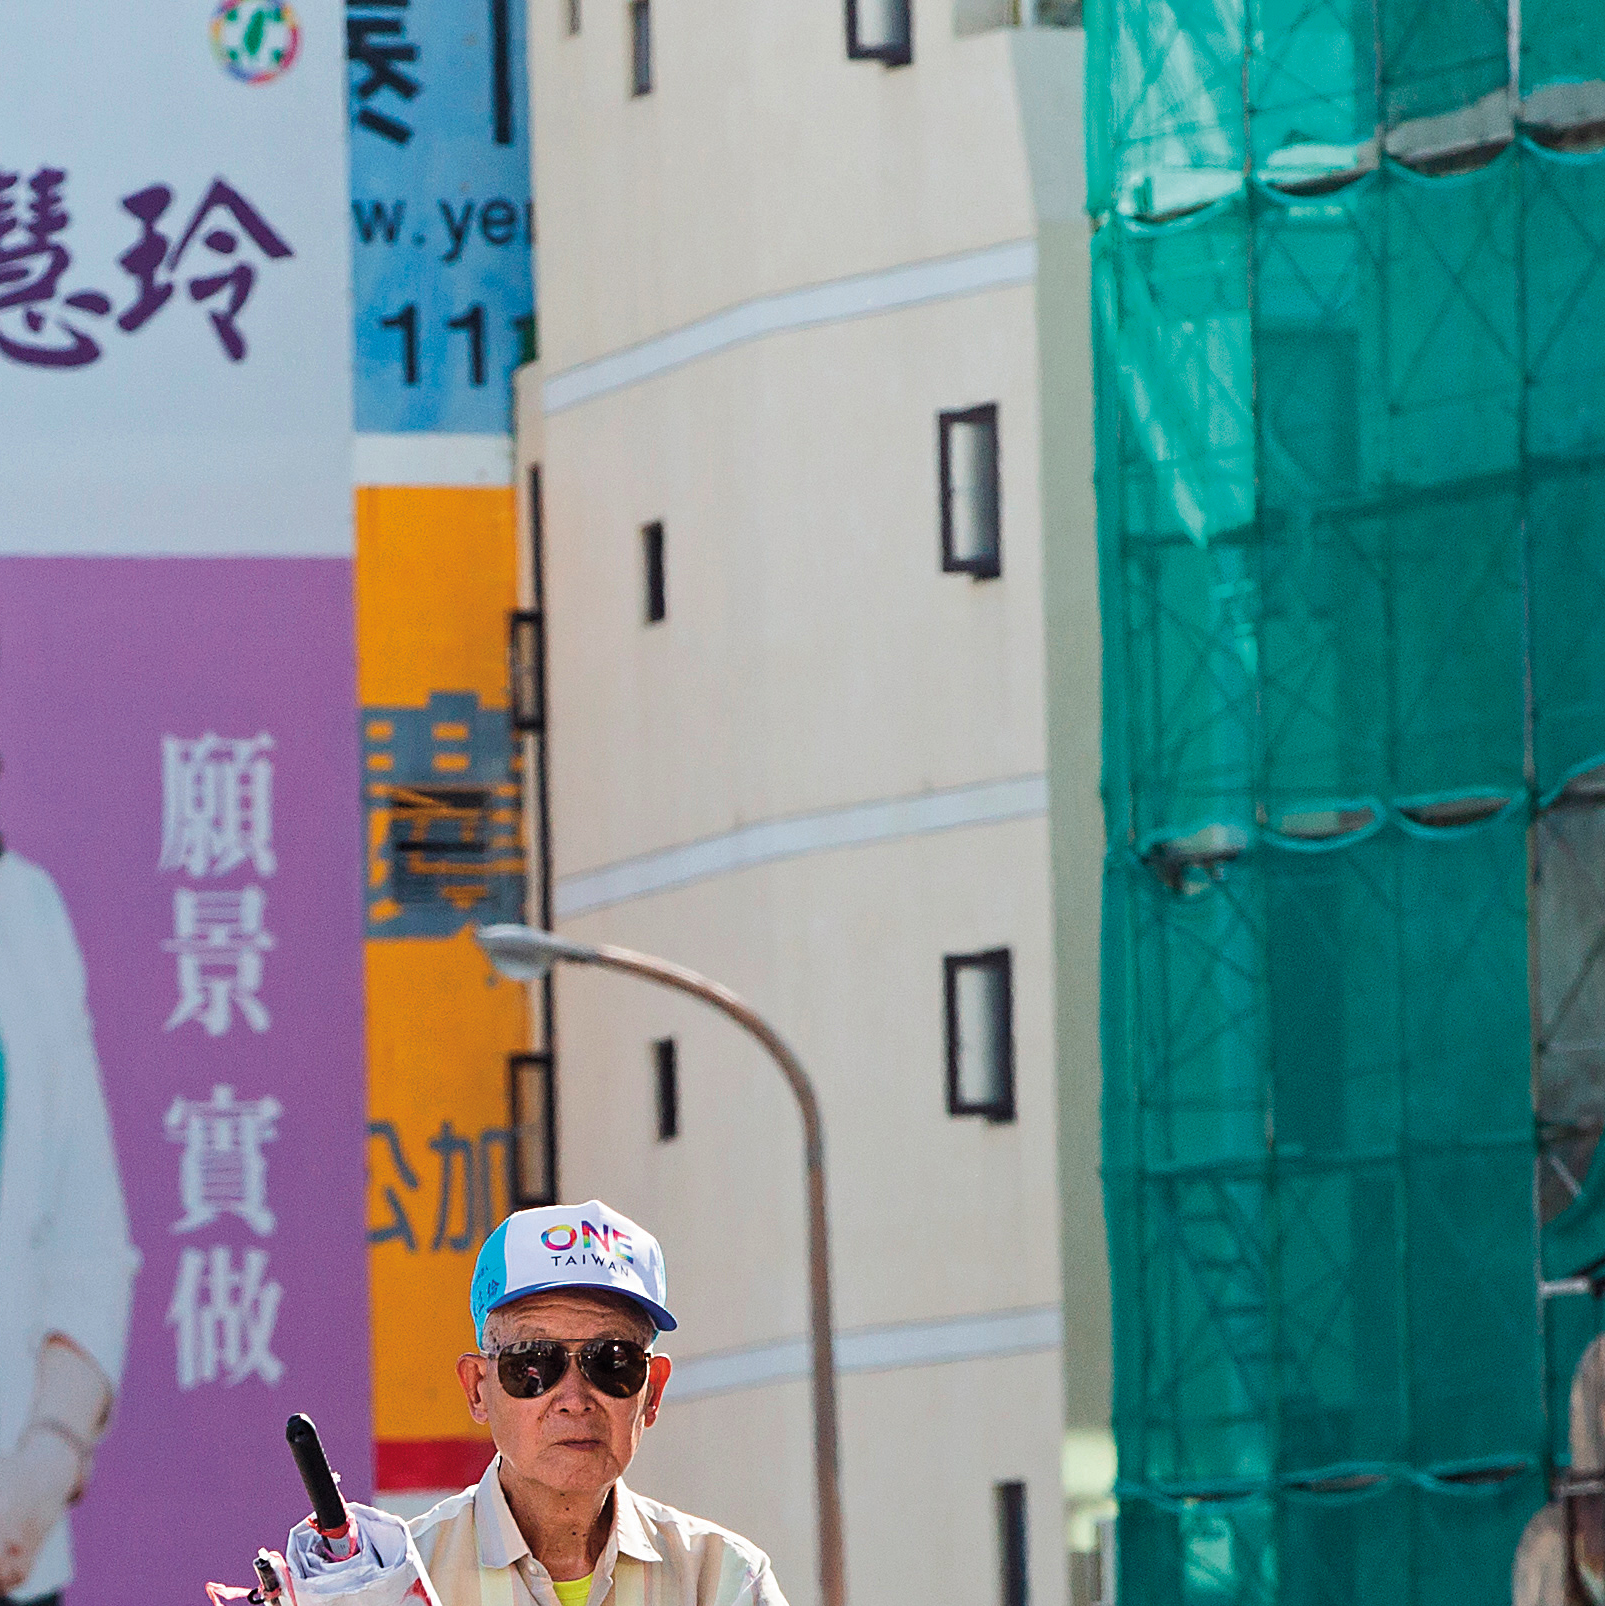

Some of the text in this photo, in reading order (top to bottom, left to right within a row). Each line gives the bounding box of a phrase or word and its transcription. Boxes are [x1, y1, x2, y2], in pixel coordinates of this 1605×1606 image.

[161, 732, 285, 1391] 願景實做
[540, 1220, 634, 1264] ONE
[550, 1253, 630, 1278] TAIWAN
